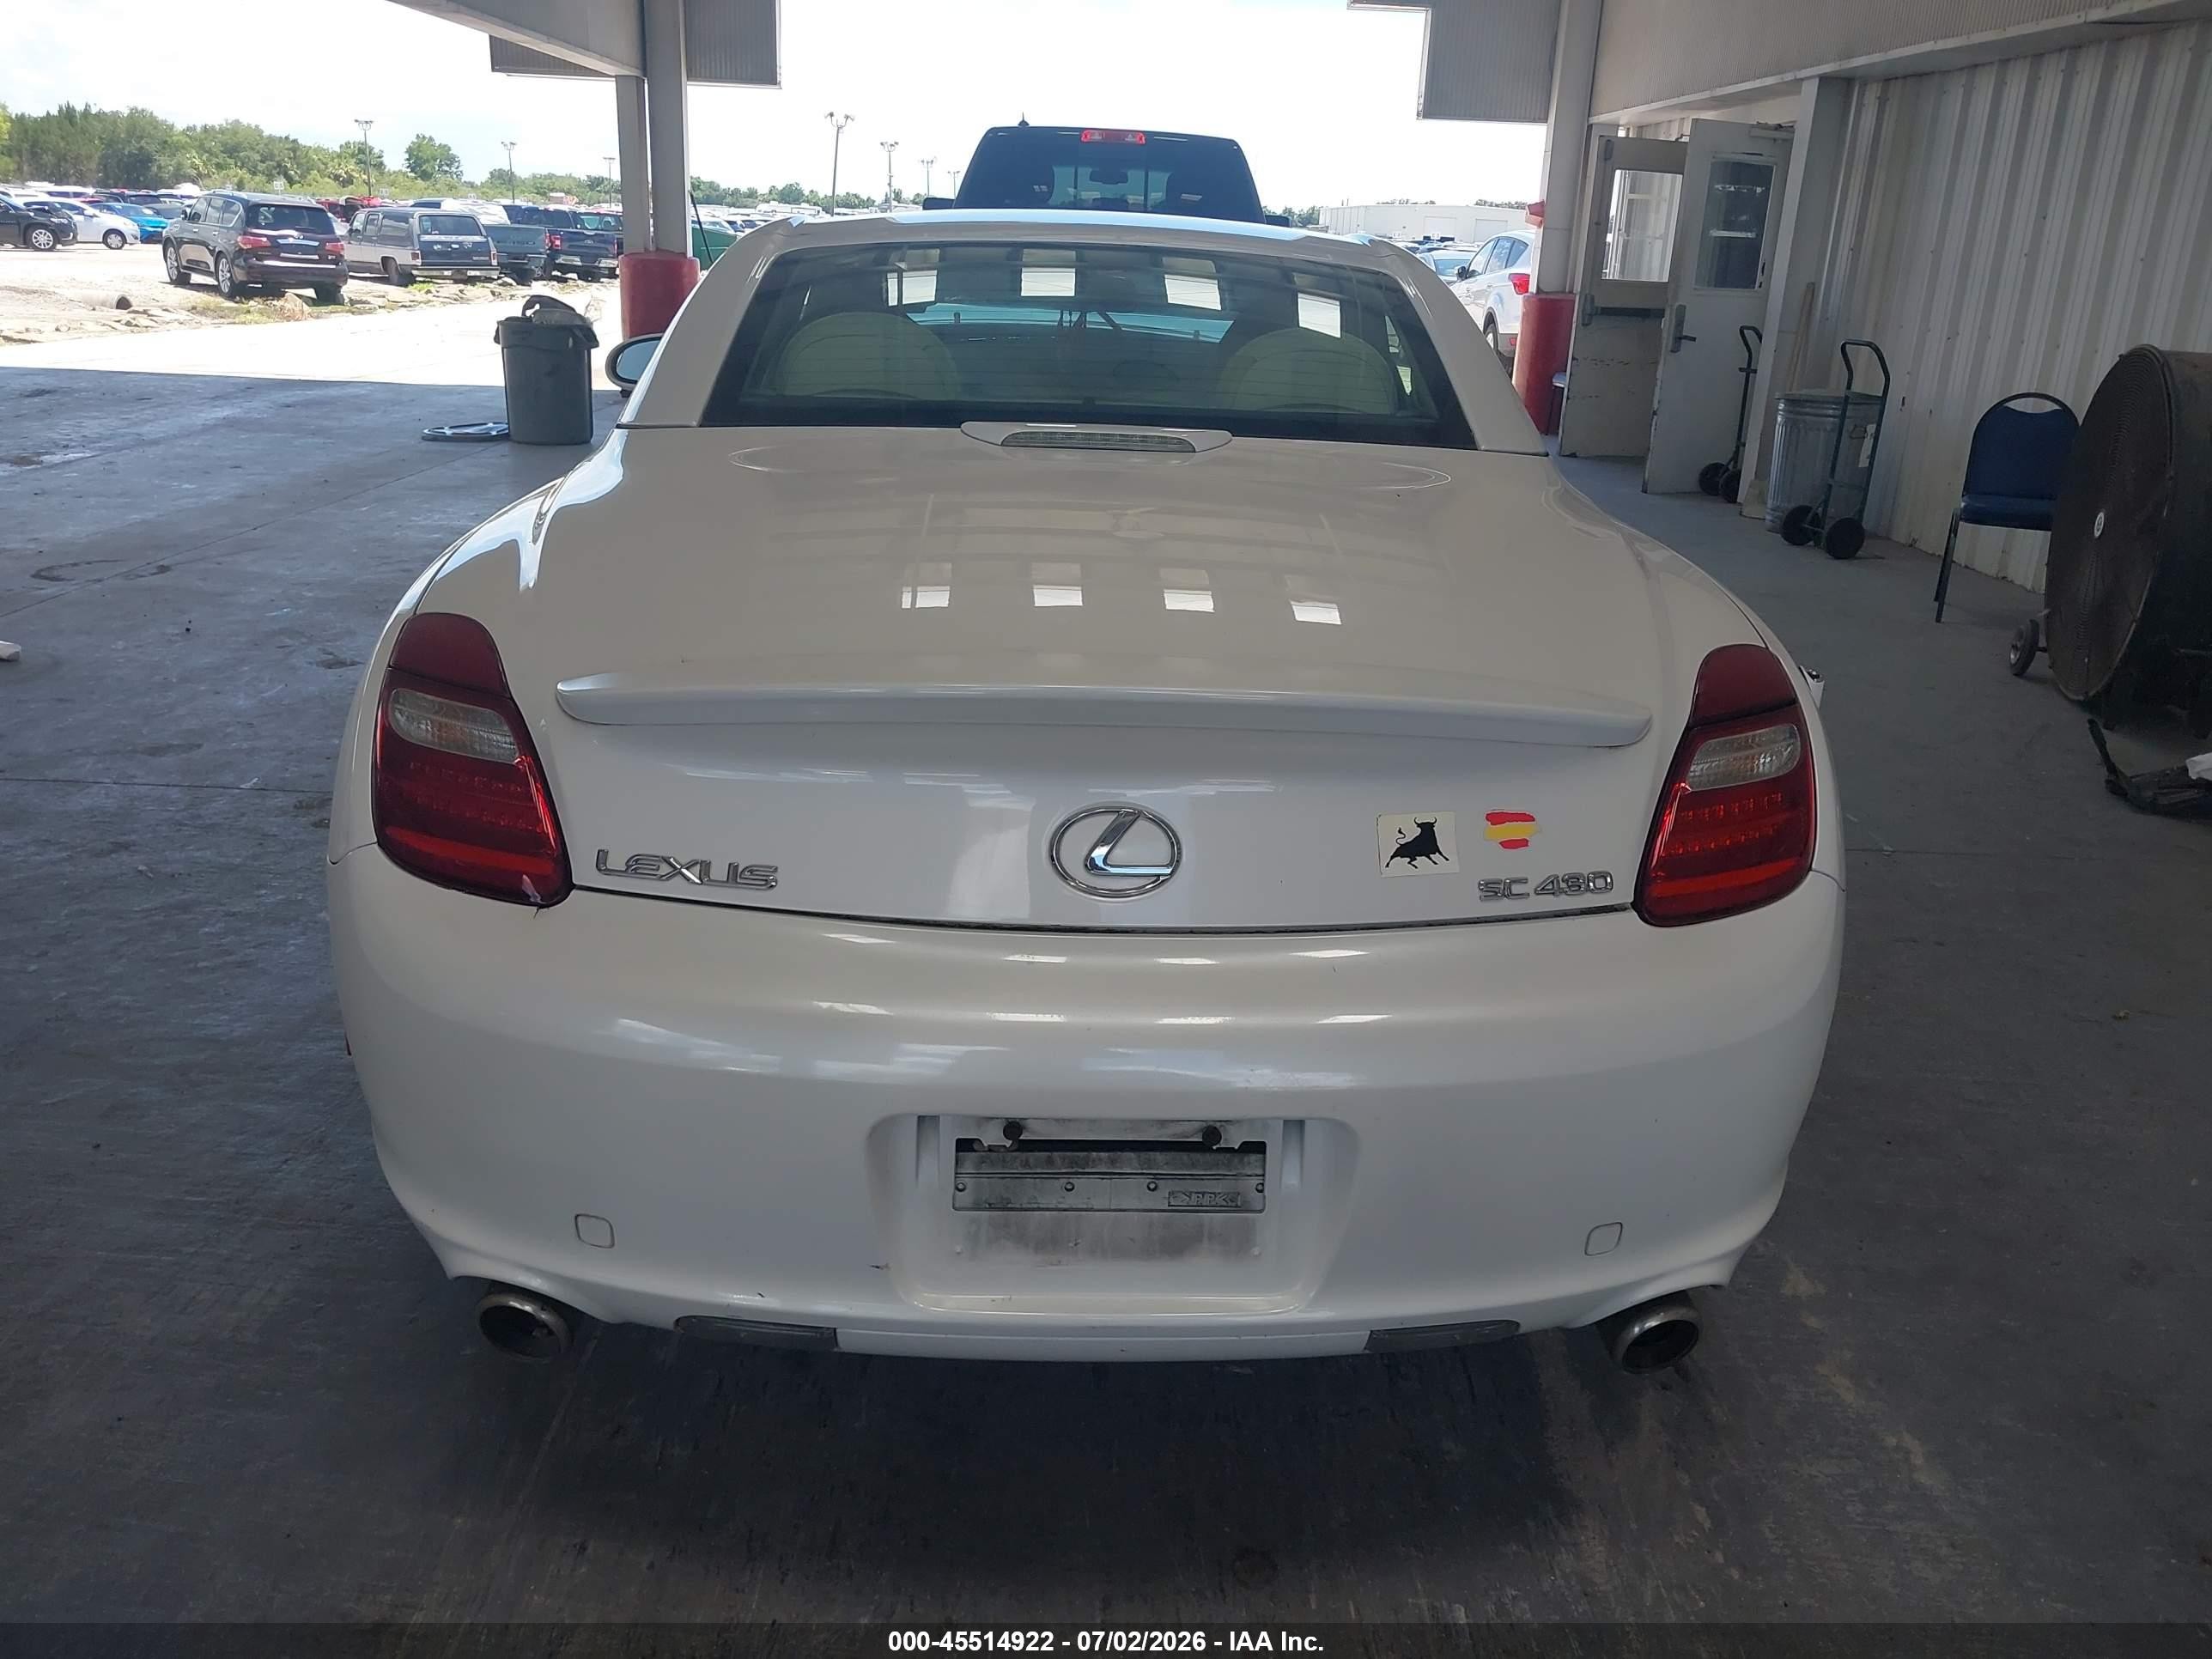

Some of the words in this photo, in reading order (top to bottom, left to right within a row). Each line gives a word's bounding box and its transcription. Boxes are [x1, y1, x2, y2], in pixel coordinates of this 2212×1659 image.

[596, 849, 777, 890] LEXUS
[1478, 878, 1529, 902] SC
[1534, 871, 1613, 897] 430
